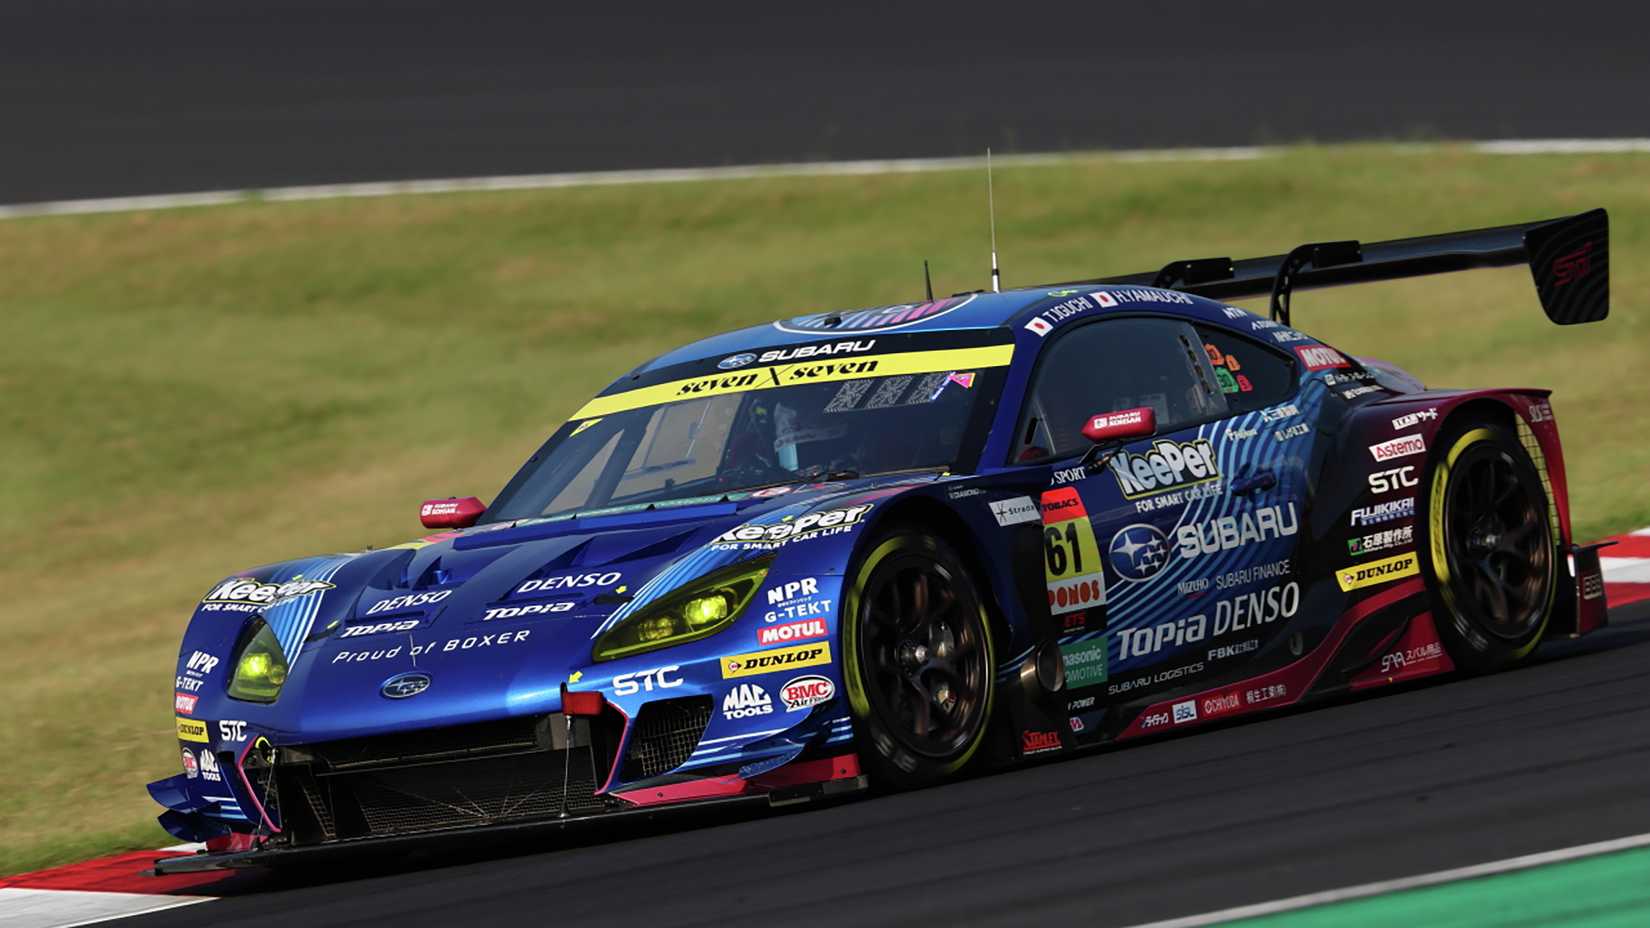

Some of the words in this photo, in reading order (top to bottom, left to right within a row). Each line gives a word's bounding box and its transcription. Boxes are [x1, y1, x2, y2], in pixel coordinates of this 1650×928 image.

[757, 339, 876, 363] SUBARU
[676, 372, 758, 396] seven
[789, 359, 879, 381] seven
[1375, 436, 1423, 458] Astemo
[1053, 466, 1086, 485] SPORT
[1110, 441, 1216, 495] KeePer
[1368, 465, 1419, 494] STC
[1136, 501, 1154, 514] FOR
[1156, 492, 1184, 510] SMART
[1351, 497, 1414, 526] FUJIKIKAI
[713, 504, 874, 542] KeePer
[1177, 502, 1298, 558] SUBARU
[742, 540, 787, 551] SMART
[793, 531, 819, 543] CAR
[822, 525, 853, 537] LIFE
[1043, 522, 1082, 576] 61
[517, 572, 621, 593] DENSO
[1216, 568, 1250, 590] SUBARU
[1253, 559, 1291, 580] FINANCE
[1357, 558, 1413, 581] DUNLOP
[366, 590, 452, 615] DENSO
[768, 577, 819, 605] NPR
[765, 600, 832, 623] G-TEKT
[1214, 581, 1300, 637] DENSO
[762, 621, 825, 643] MOTUL
[332, 646, 401, 664] Proud
[409, 642, 436, 656] of
[443, 630, 530, 652] BOXER
[744, 649, 823, 669] DUNLOP
[186, 651, 219, 674] NPR
[612, 666, 684, 696] STC
[787, 682, 830, 700] BMC
[1108, 678, 1150, 695] SUBARU
[1154, 662, 1204, 682] LOGISTICS
[723, 684, 773, 711] MAC
[723, 705, 774, 720] TOOLS
[219, 720, 247, 741] STC
